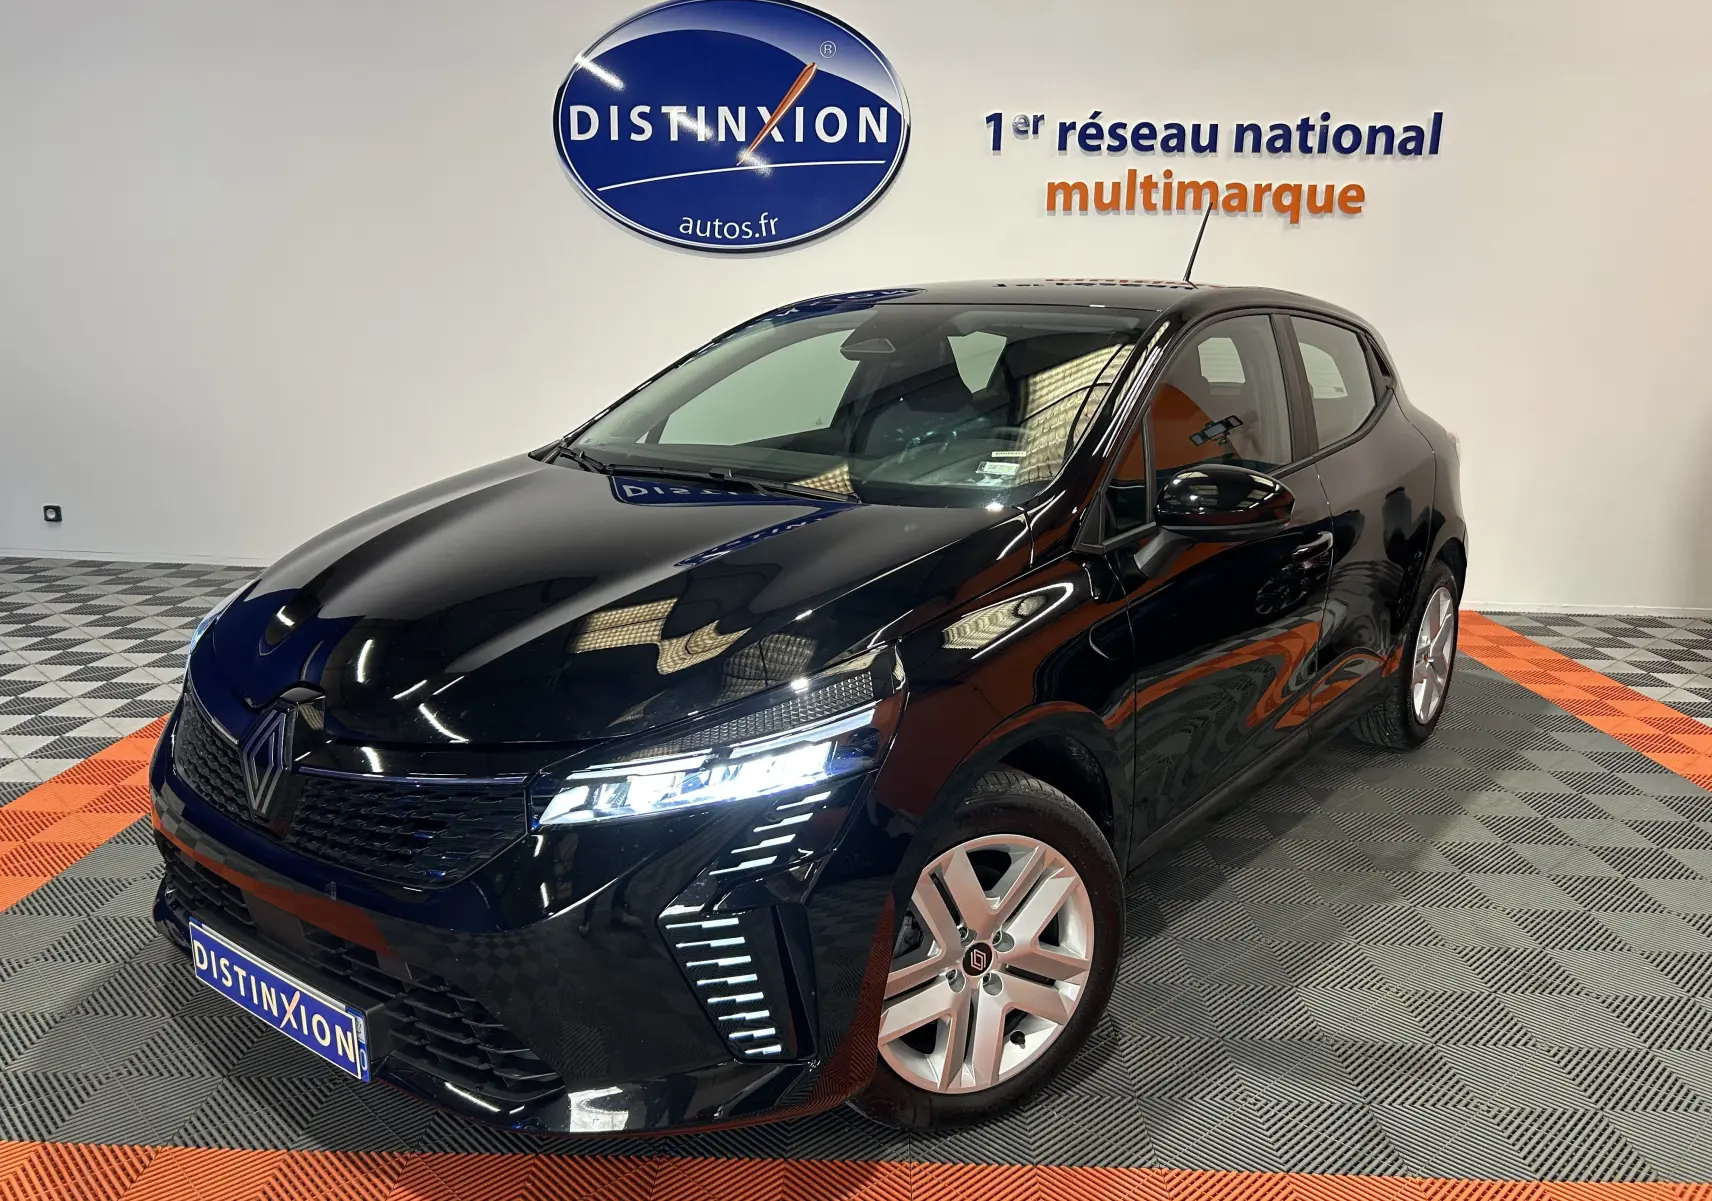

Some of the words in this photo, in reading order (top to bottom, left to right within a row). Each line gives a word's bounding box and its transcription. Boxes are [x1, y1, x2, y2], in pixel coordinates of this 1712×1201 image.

[569, 105, 888, 143] DISTINXION
[1057, 110, 1218, 153] réseau
[1233, 112, 1444, 155] national
[1046, 168, 1365, 224] multimarque
[679, 212, 779, 240] autos.fr
[193, 938, 355, 1063] DISTINXION
